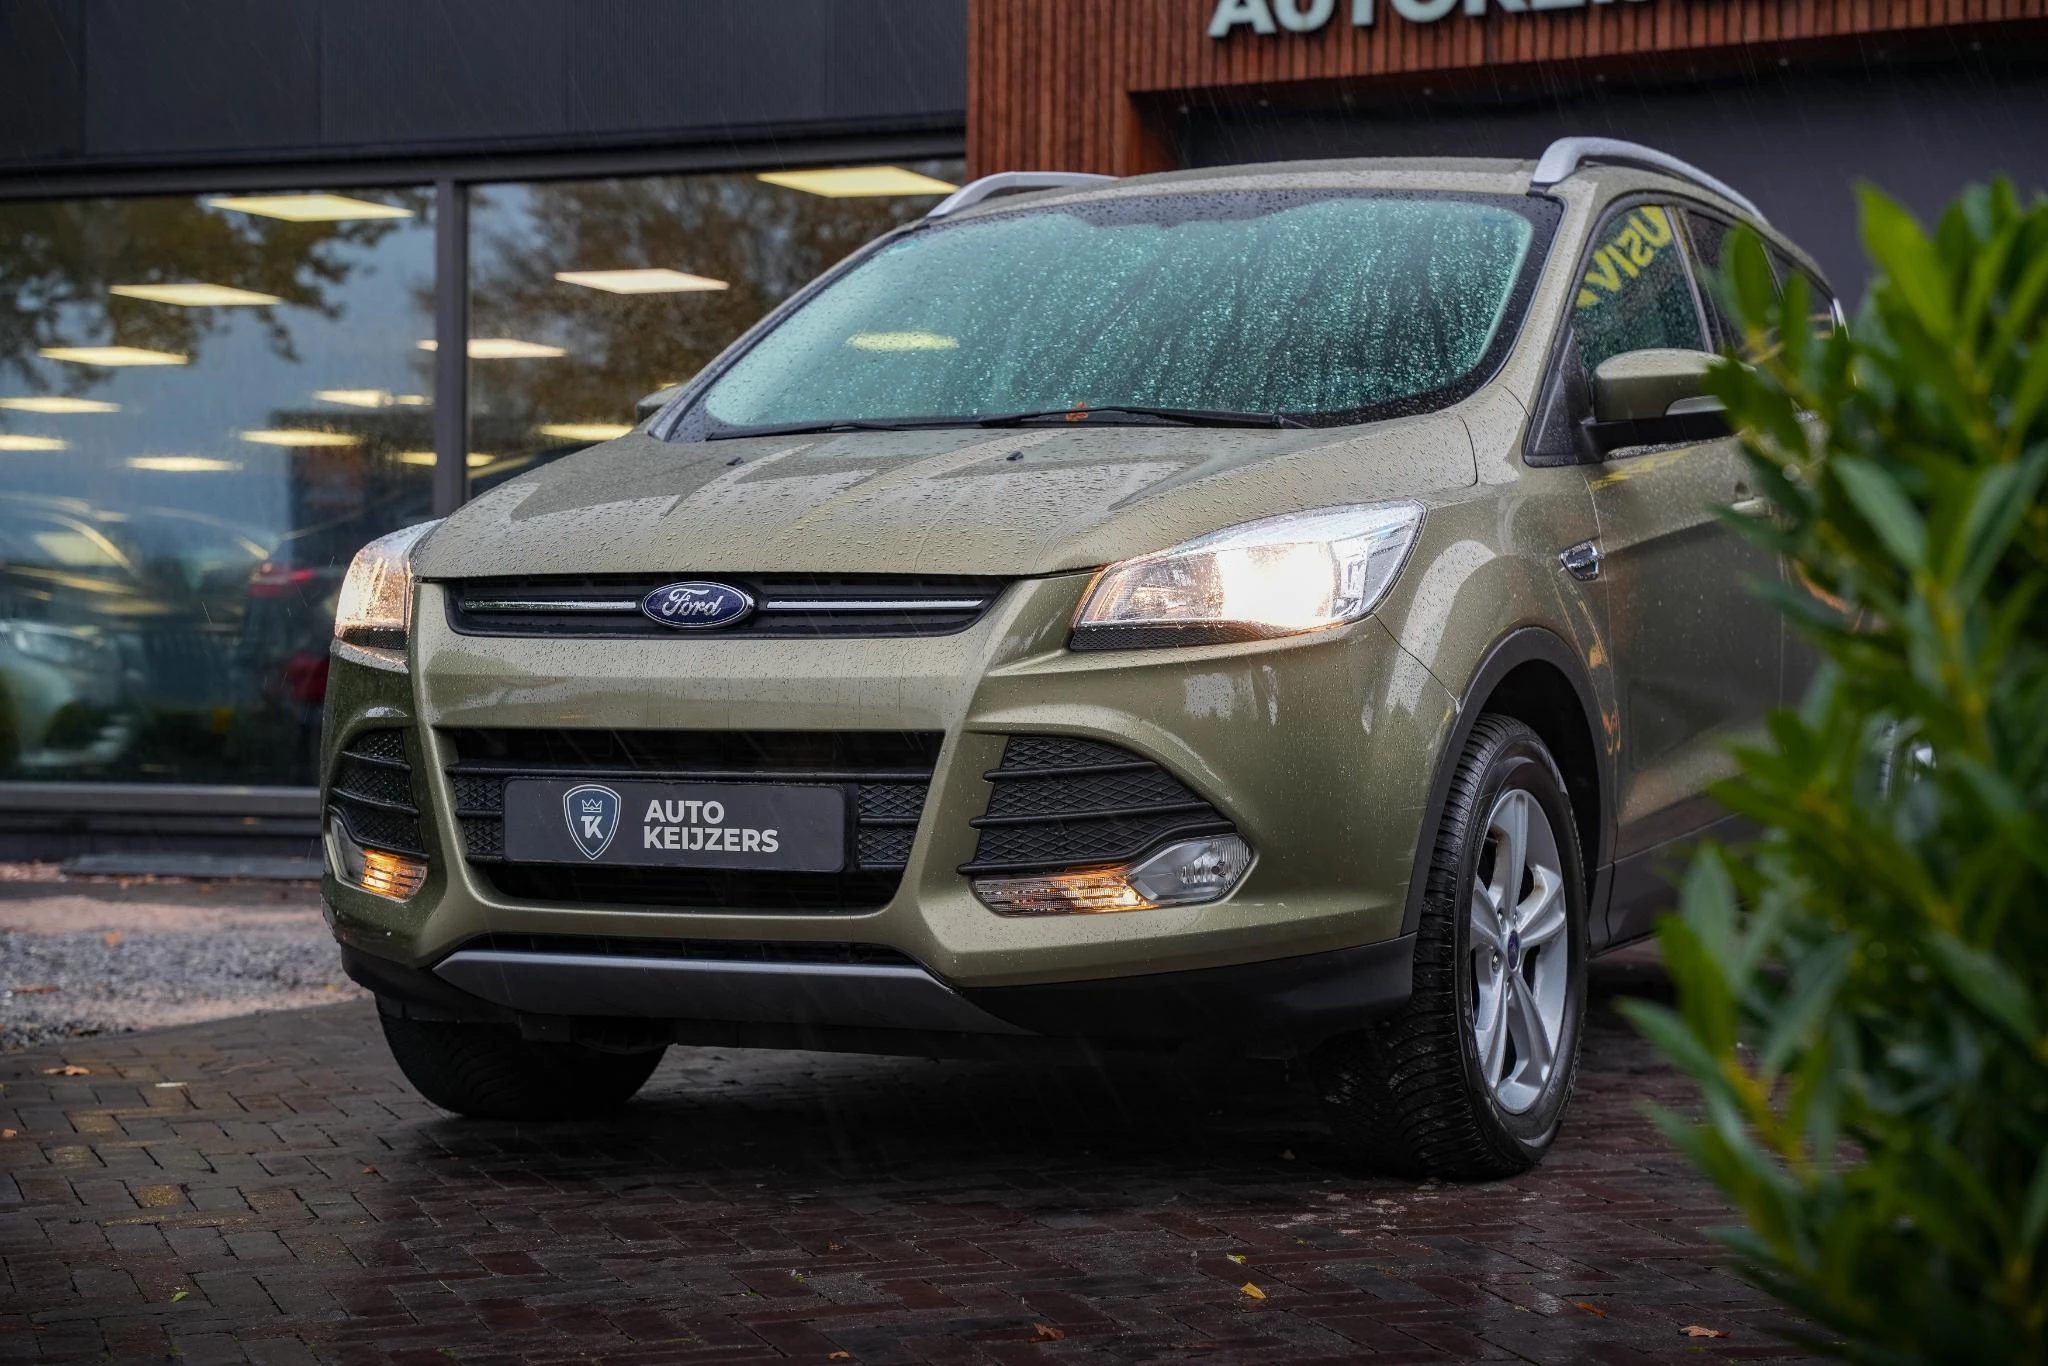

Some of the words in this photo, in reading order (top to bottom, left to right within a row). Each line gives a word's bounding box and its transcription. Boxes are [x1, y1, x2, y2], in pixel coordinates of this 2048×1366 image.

[662, 588, 724, 616] Ford
[643, 799, 725, 825] AUTO
[643, 825, 779, 853] KEIJZERS
